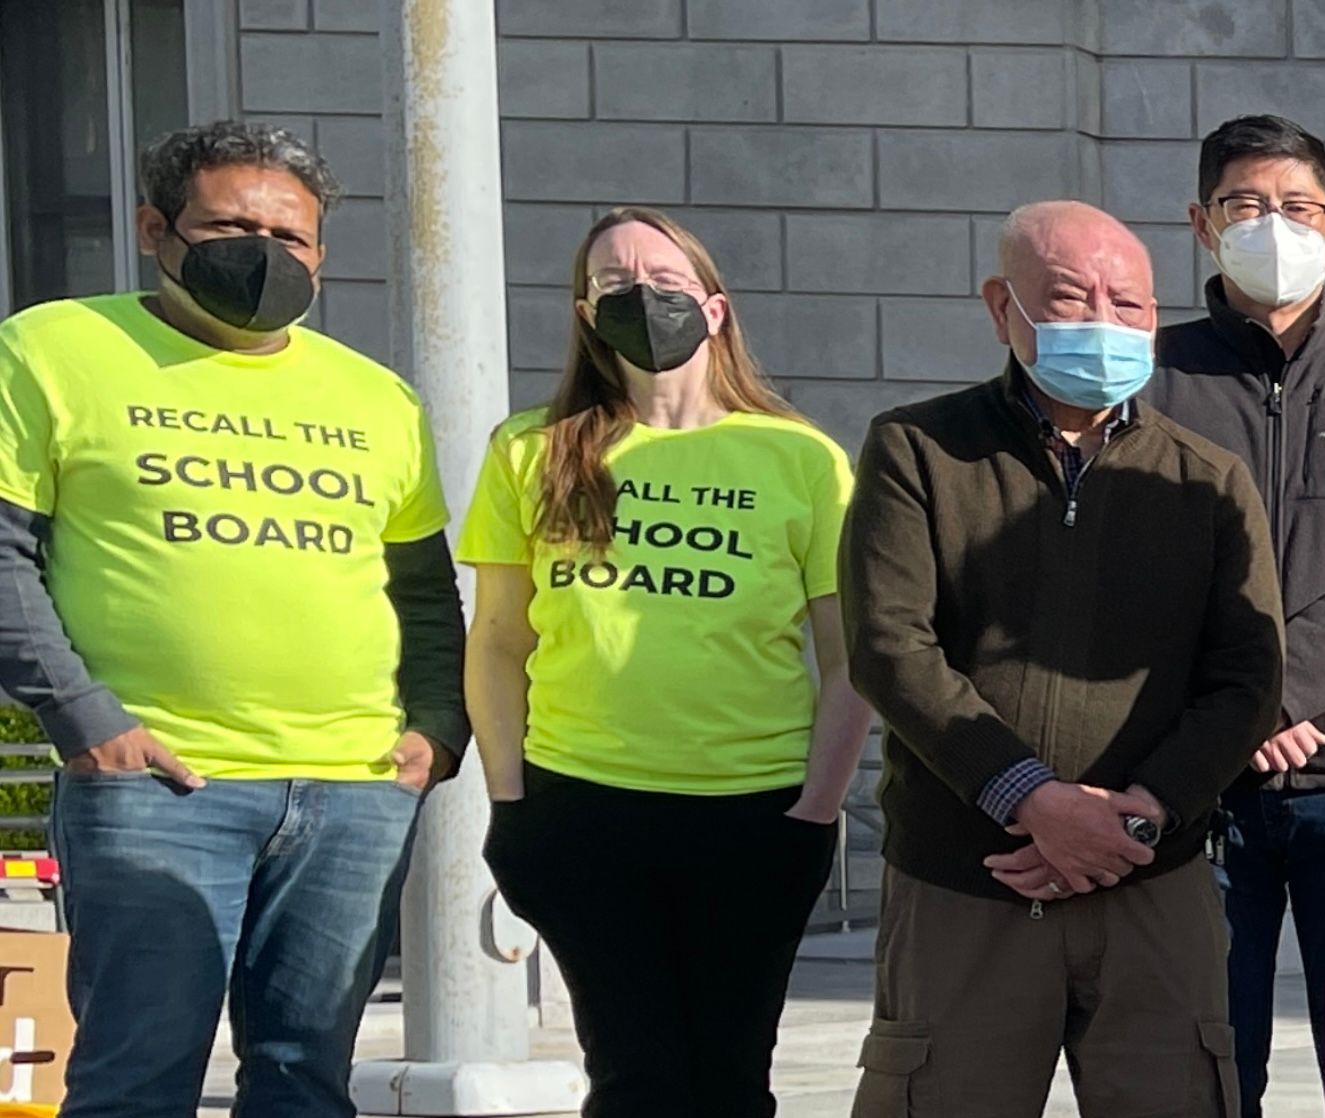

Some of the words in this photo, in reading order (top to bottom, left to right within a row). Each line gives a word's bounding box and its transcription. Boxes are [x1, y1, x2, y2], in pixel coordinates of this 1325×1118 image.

[127, 404, 287, 440] RECALL
[293, 421, 369, 451] THE
[135, 453, 375, 507] SCHOOL
[691, 487, 757, 509] THE
[162, 510, 354, 554] BOARD
[551, 559, 735, 599] BOARD
